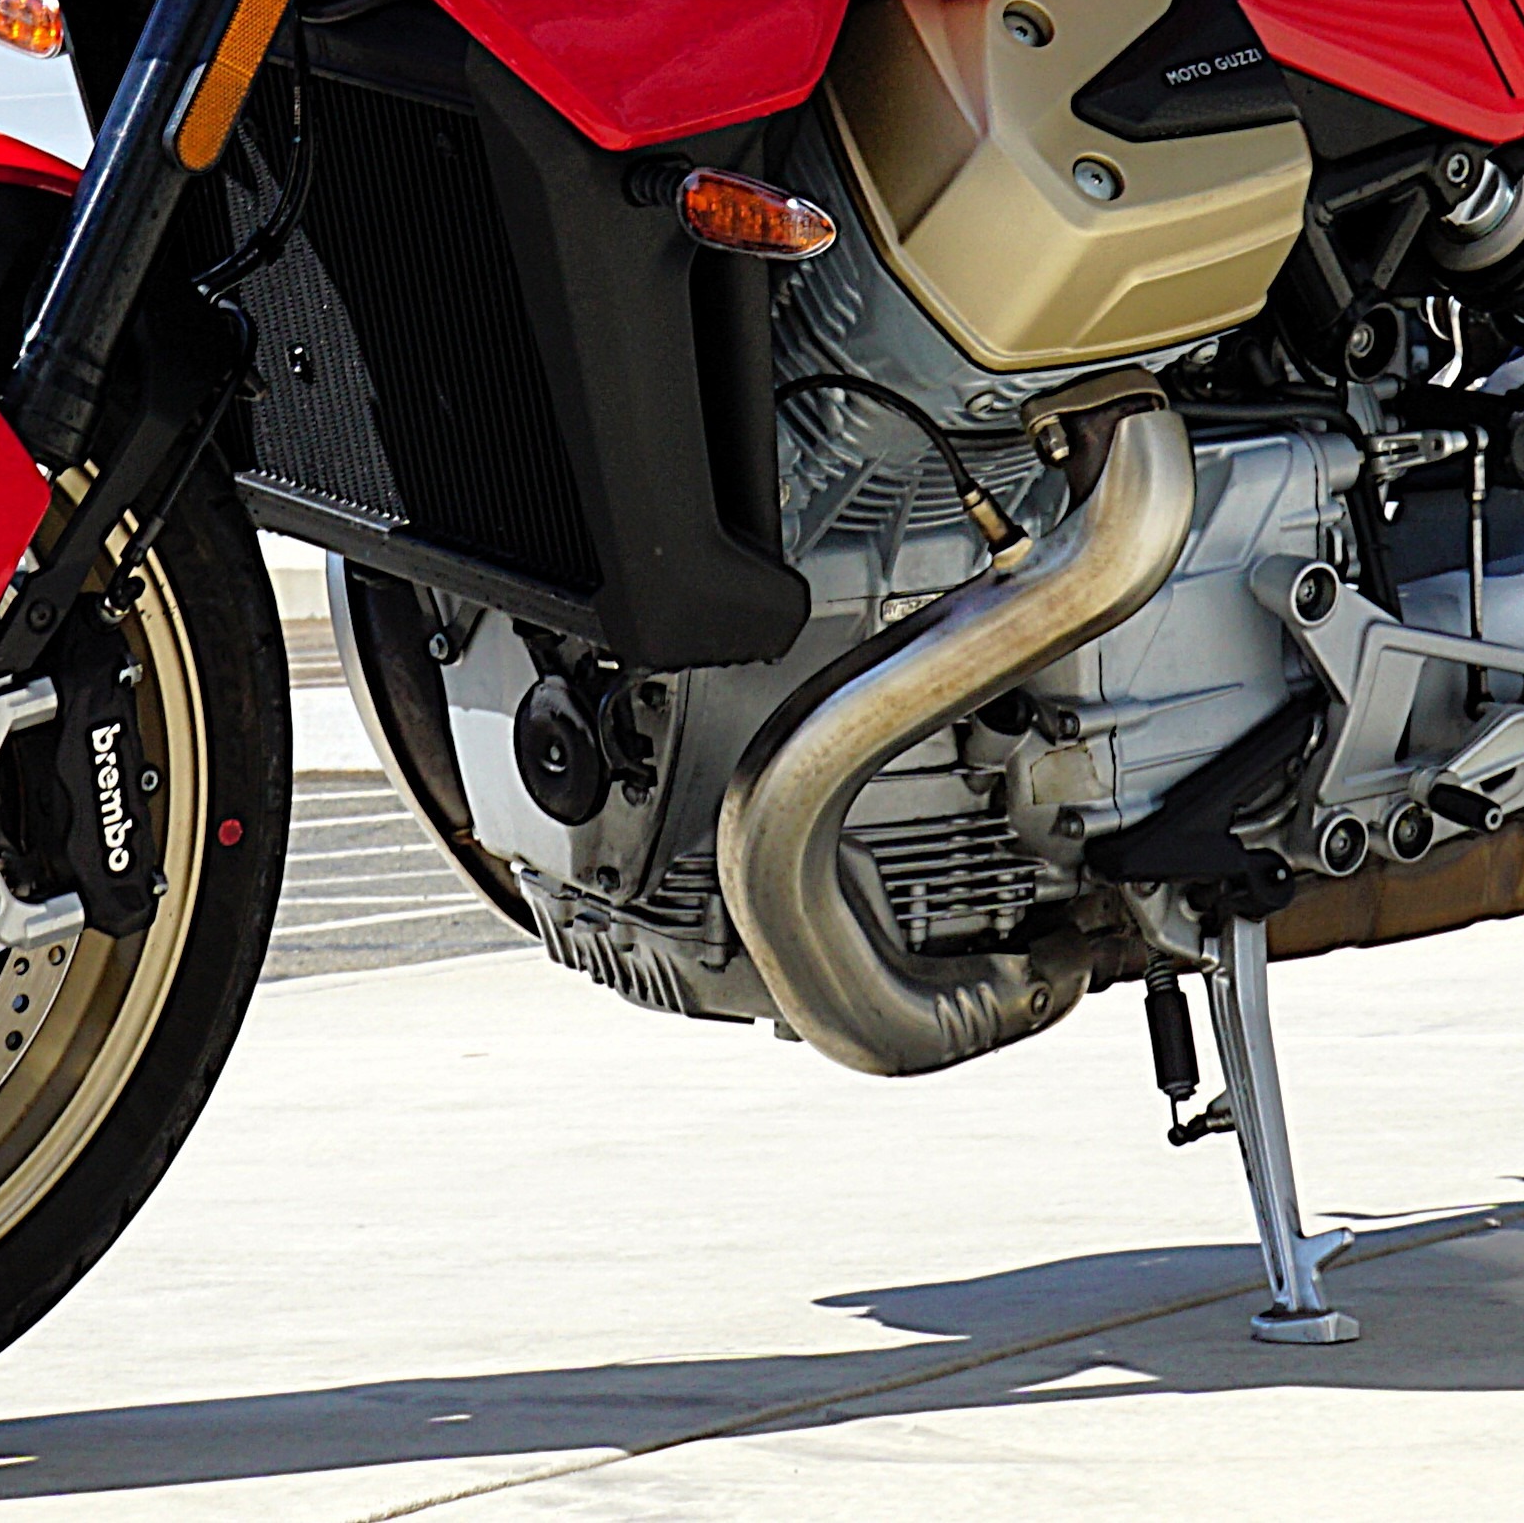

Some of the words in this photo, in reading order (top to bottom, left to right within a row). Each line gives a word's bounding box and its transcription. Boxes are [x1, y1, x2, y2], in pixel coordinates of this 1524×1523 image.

[1165, 62, 1212, 86] MOTO
[1214, 48, 1263, 71] GUZZI
[91, 723, 133, 873] brembo
